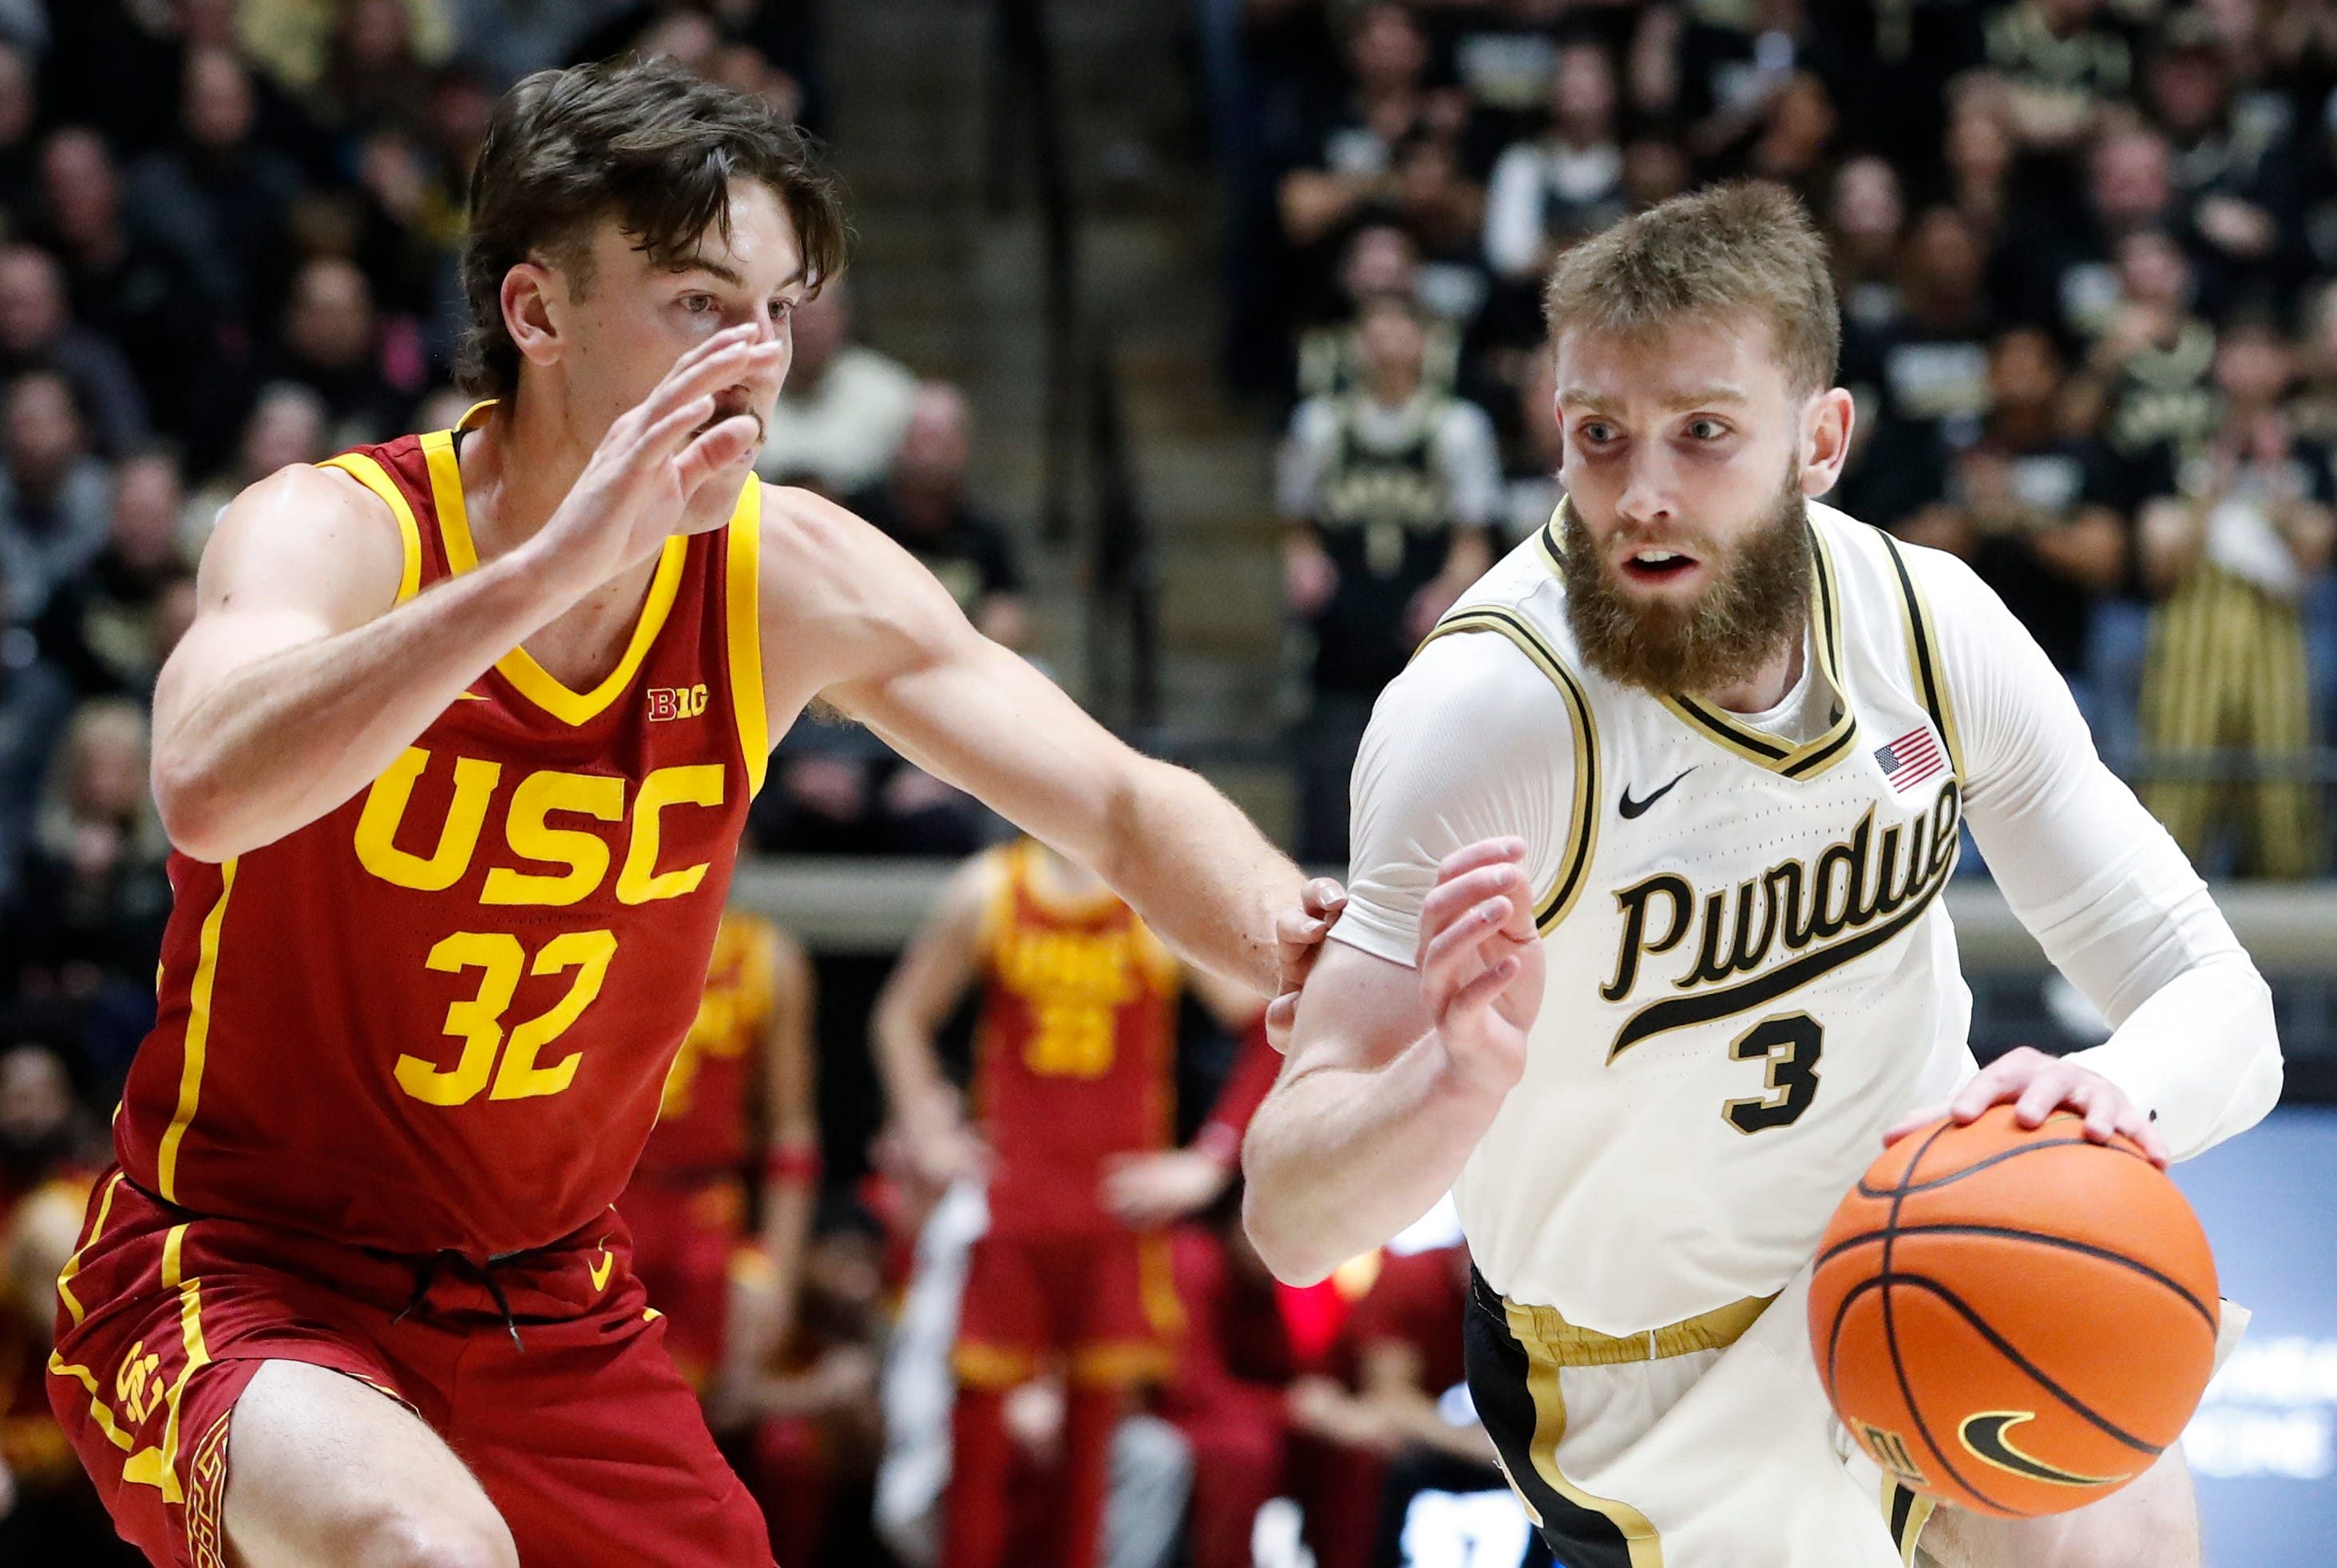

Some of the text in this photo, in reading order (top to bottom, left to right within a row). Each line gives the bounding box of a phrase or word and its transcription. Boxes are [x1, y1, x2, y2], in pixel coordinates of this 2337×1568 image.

[354, 746, 725, 906] USC
[1599, 775, 1962, 1004] Purdue
[393, 929, 618, 1107] 32
[1721, 1009, 1825, 1136] 3
